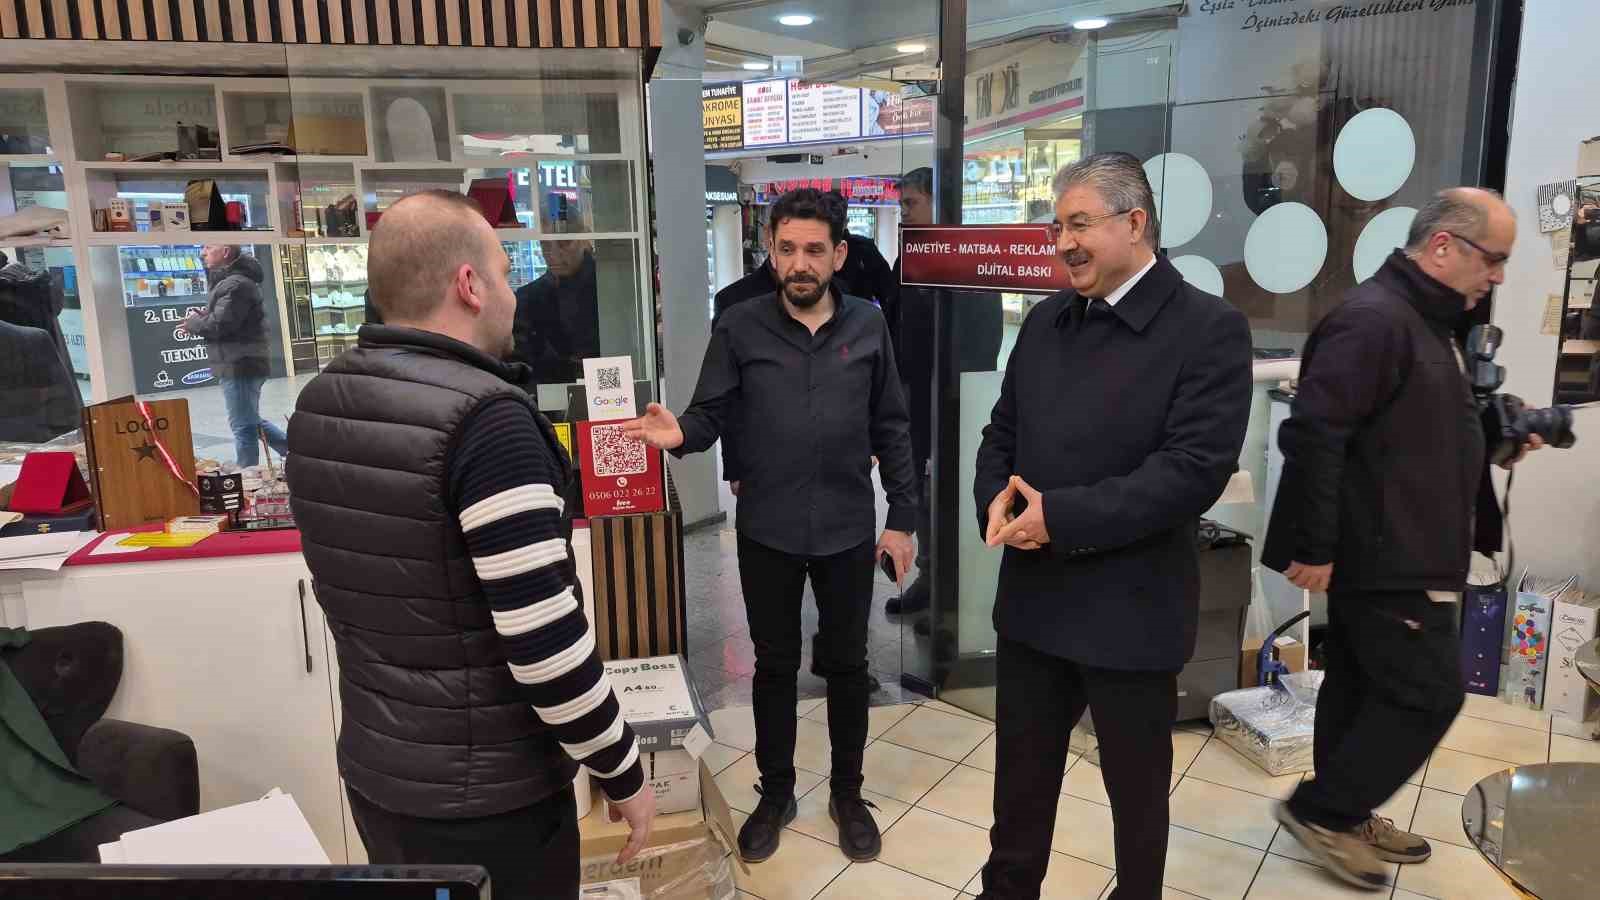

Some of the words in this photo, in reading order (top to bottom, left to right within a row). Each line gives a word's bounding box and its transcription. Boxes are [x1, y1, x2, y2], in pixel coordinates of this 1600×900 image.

[1240, 9, 1321, 32] İçinizdeki
[1325, 0, 1423, 23] Güzellikleri
[517, 163, 577, 187] ETEL
[906, 241, 951, 254] DAVETİYE
[960, 243, 1001, 255] MATBAA
[1009, 244, 1056, 256] REKLAM
[977, 262, 1015, 276] DİJİTAL
[1018, 265, 1051, 277] BASKI
[144, 310, 160, 323] 2.
[592, 395, 628, 408] Google
[115, 417, 168, 434] LOGO
[589, 490, 612, 500] 0506
[613, 488, 629, 498] 022
[632, 487, 642, 497] 26
[646, 486, 656, 495] 22
[641, 663, 676, 671] Boss
[624, 685, 642, 693] A4
